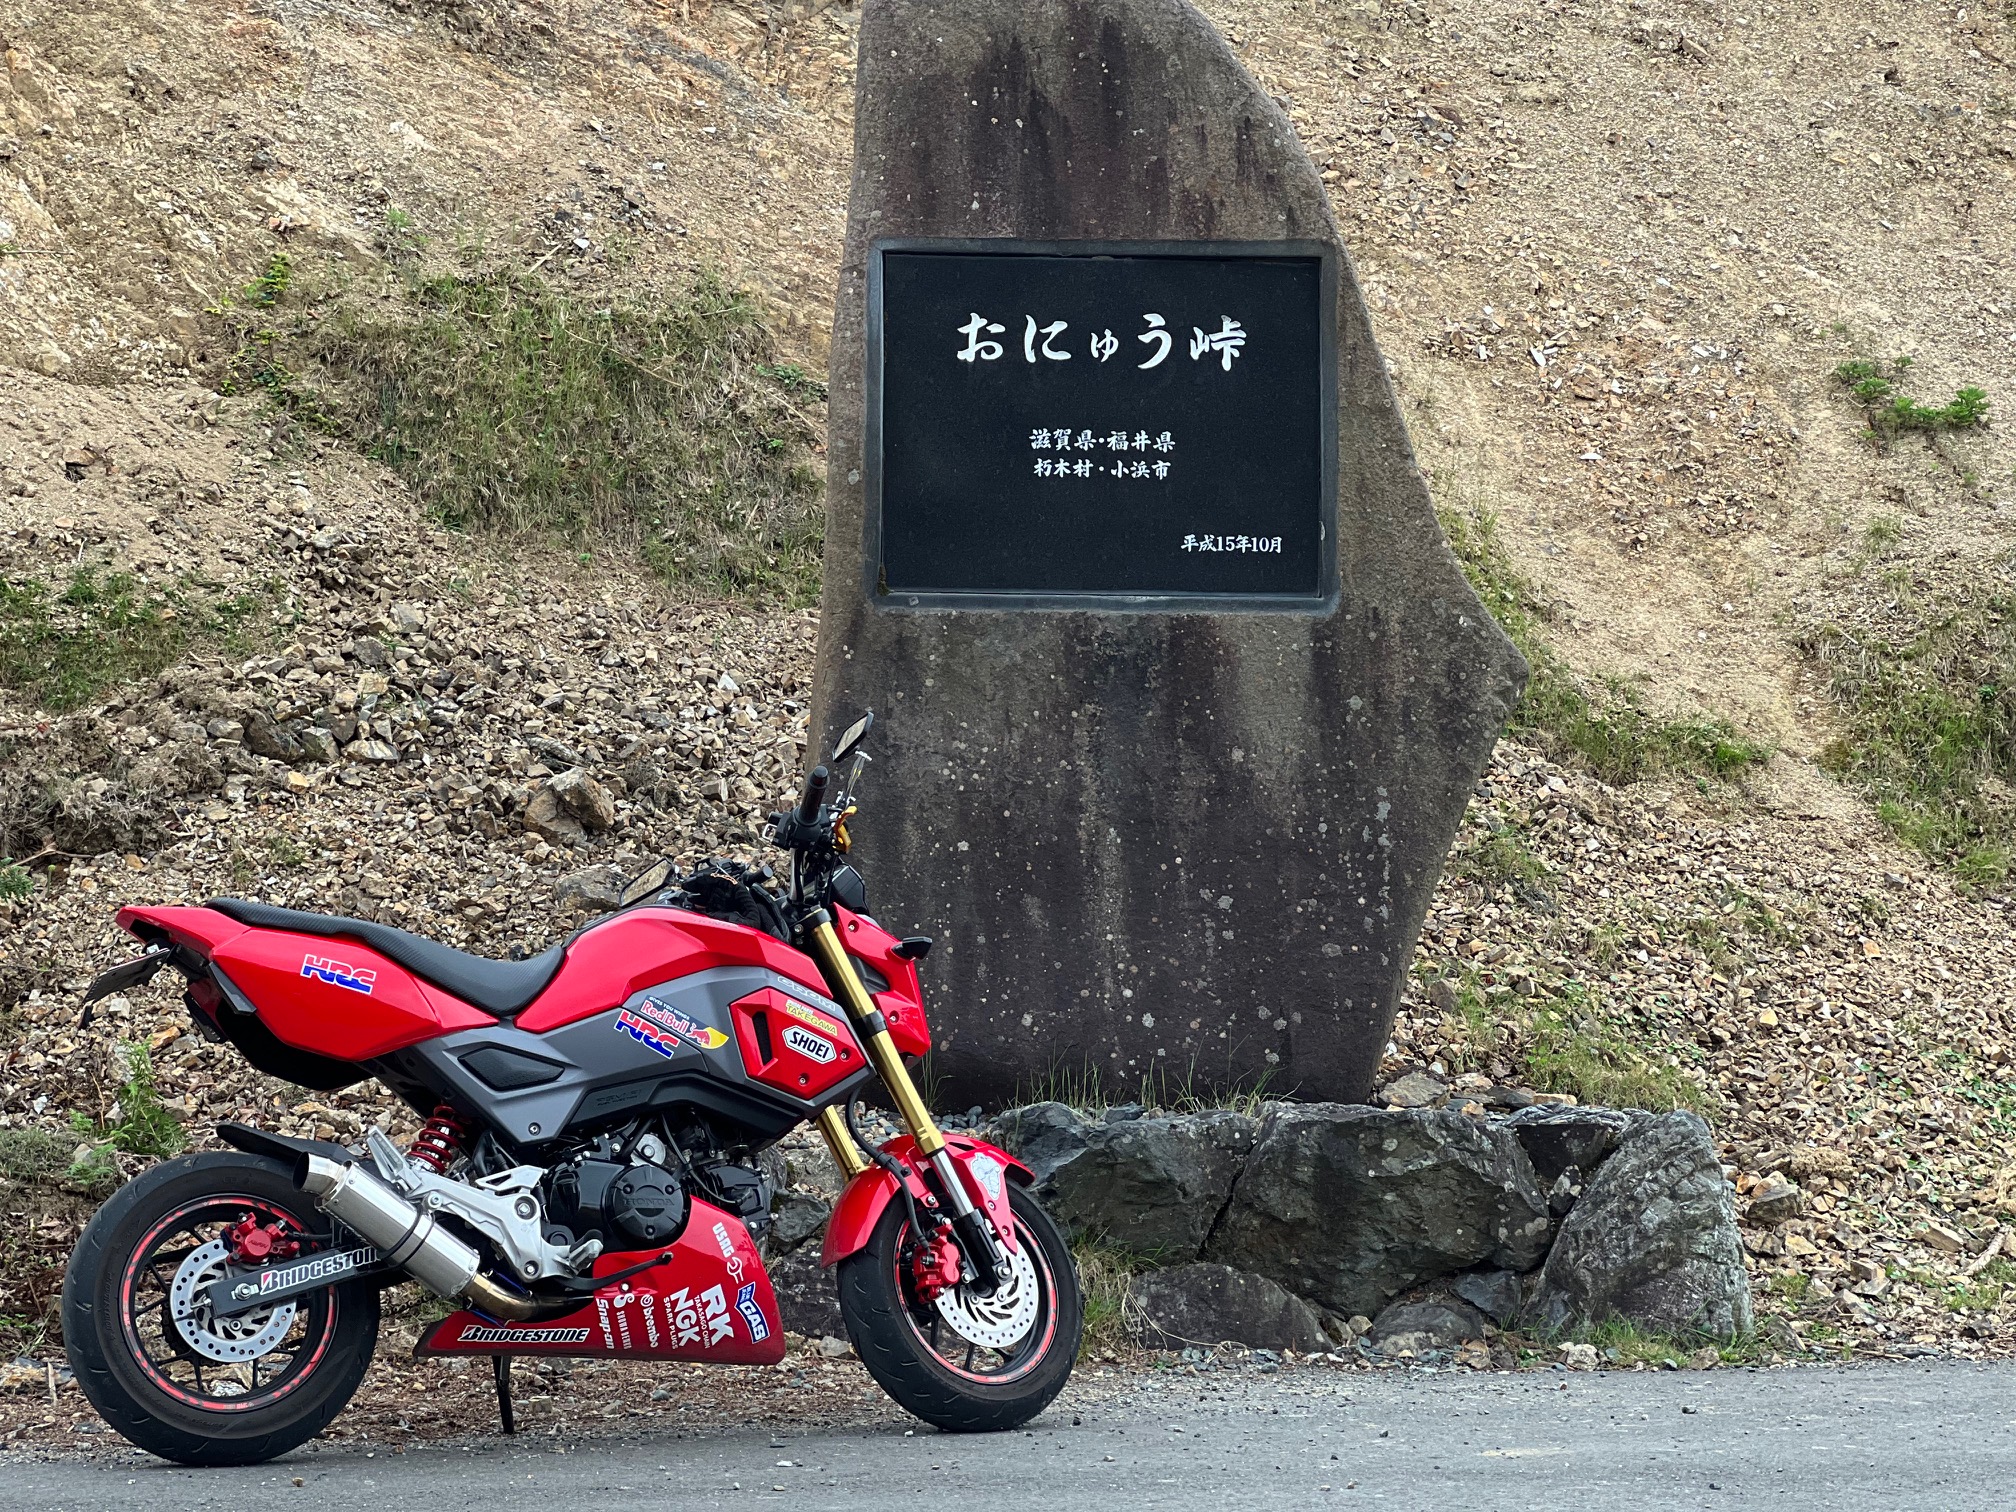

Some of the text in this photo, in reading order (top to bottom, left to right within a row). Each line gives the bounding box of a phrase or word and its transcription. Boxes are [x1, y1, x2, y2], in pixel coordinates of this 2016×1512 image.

[956, 312, 1247, 371] おにゅう峠
[1029, 428, 1176, 453] 滋賀県・福井県
[1033, 458, 1172, 480] 朽木村・小浜市
[1180, 534, 1283, 554] 平成15年10月
[300, 954, 377, 995] HRC
[614, 1009, 679, 1060] HRC
[786, 1004, 838, 1036] TAKEGAWA
[789, 1031, 830, 1060] SHOEI
[712, 1222, 735, 1258] USAG
[457, 1325, 591, 1342] BRIDGESTONE
[596, 1298, 615, 1349] Snap-on
[643, 1306, 659, 1348] brembo
[663, 1297, 679, 1349] SPARK PLUGS
[670, 1287, 702, 1347] NGK
[701, 1283, 734, 1346] RK
[739, 1300, 766, 1342] GAS
